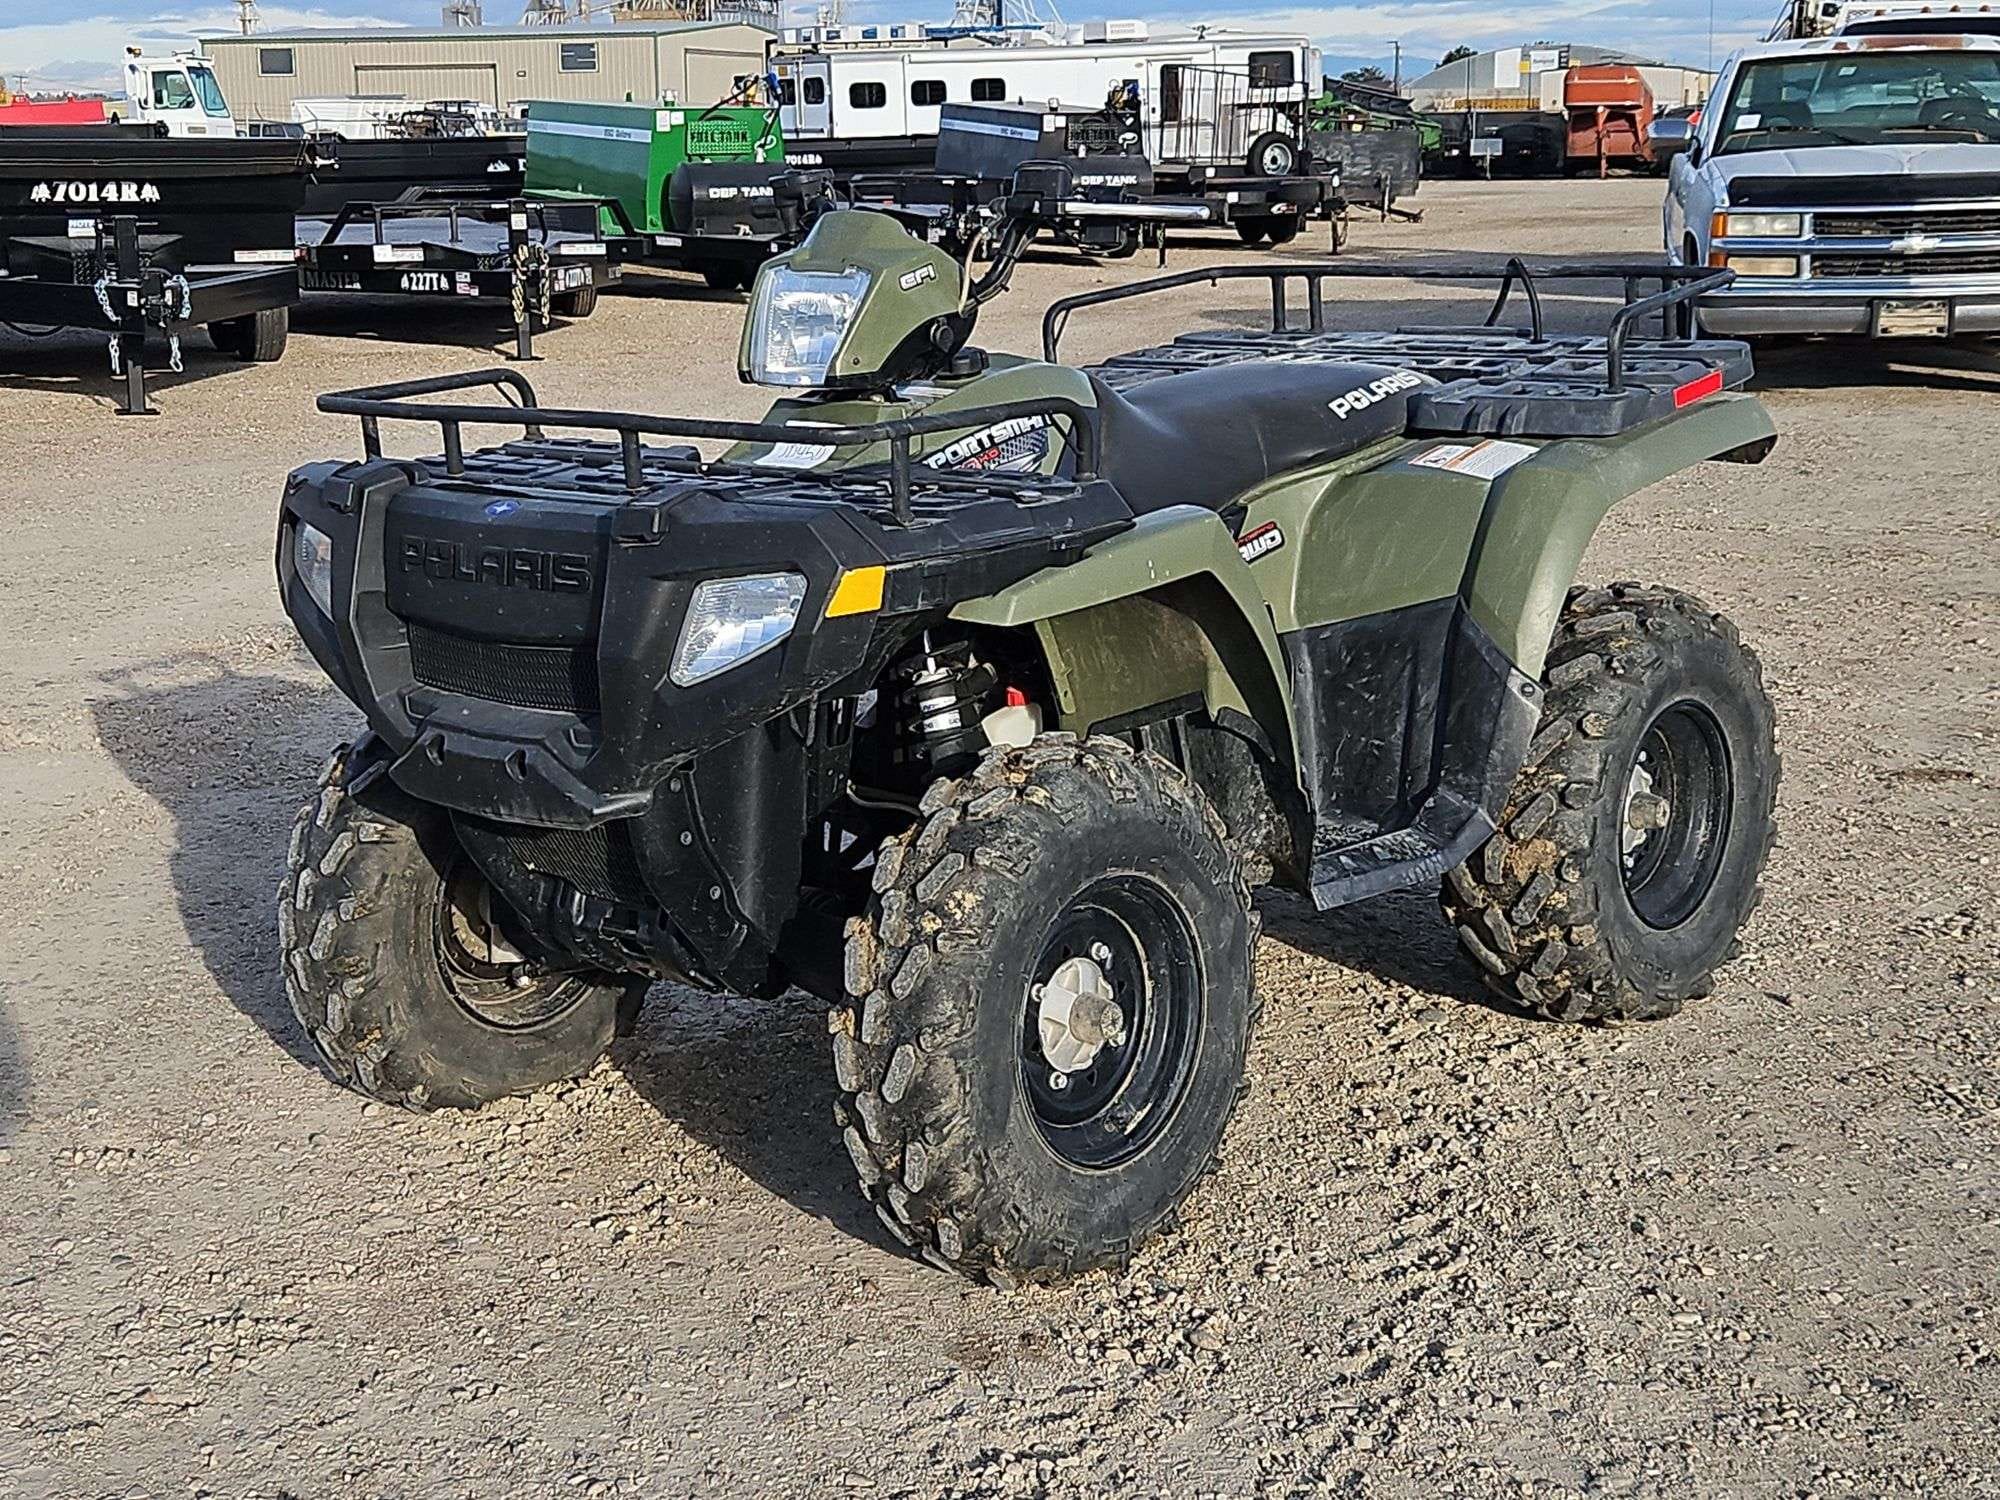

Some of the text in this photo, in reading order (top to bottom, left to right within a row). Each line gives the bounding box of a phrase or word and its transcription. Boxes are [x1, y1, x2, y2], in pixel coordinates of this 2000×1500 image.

[52, 181, 140, 202] 7014R
[306, 271, 362, 290] MASTER
[409, 272, 439, 291] 227T
[1328, 371, 1422, 420] POLARIS
[401, 534, 592, 594] POLARIS
